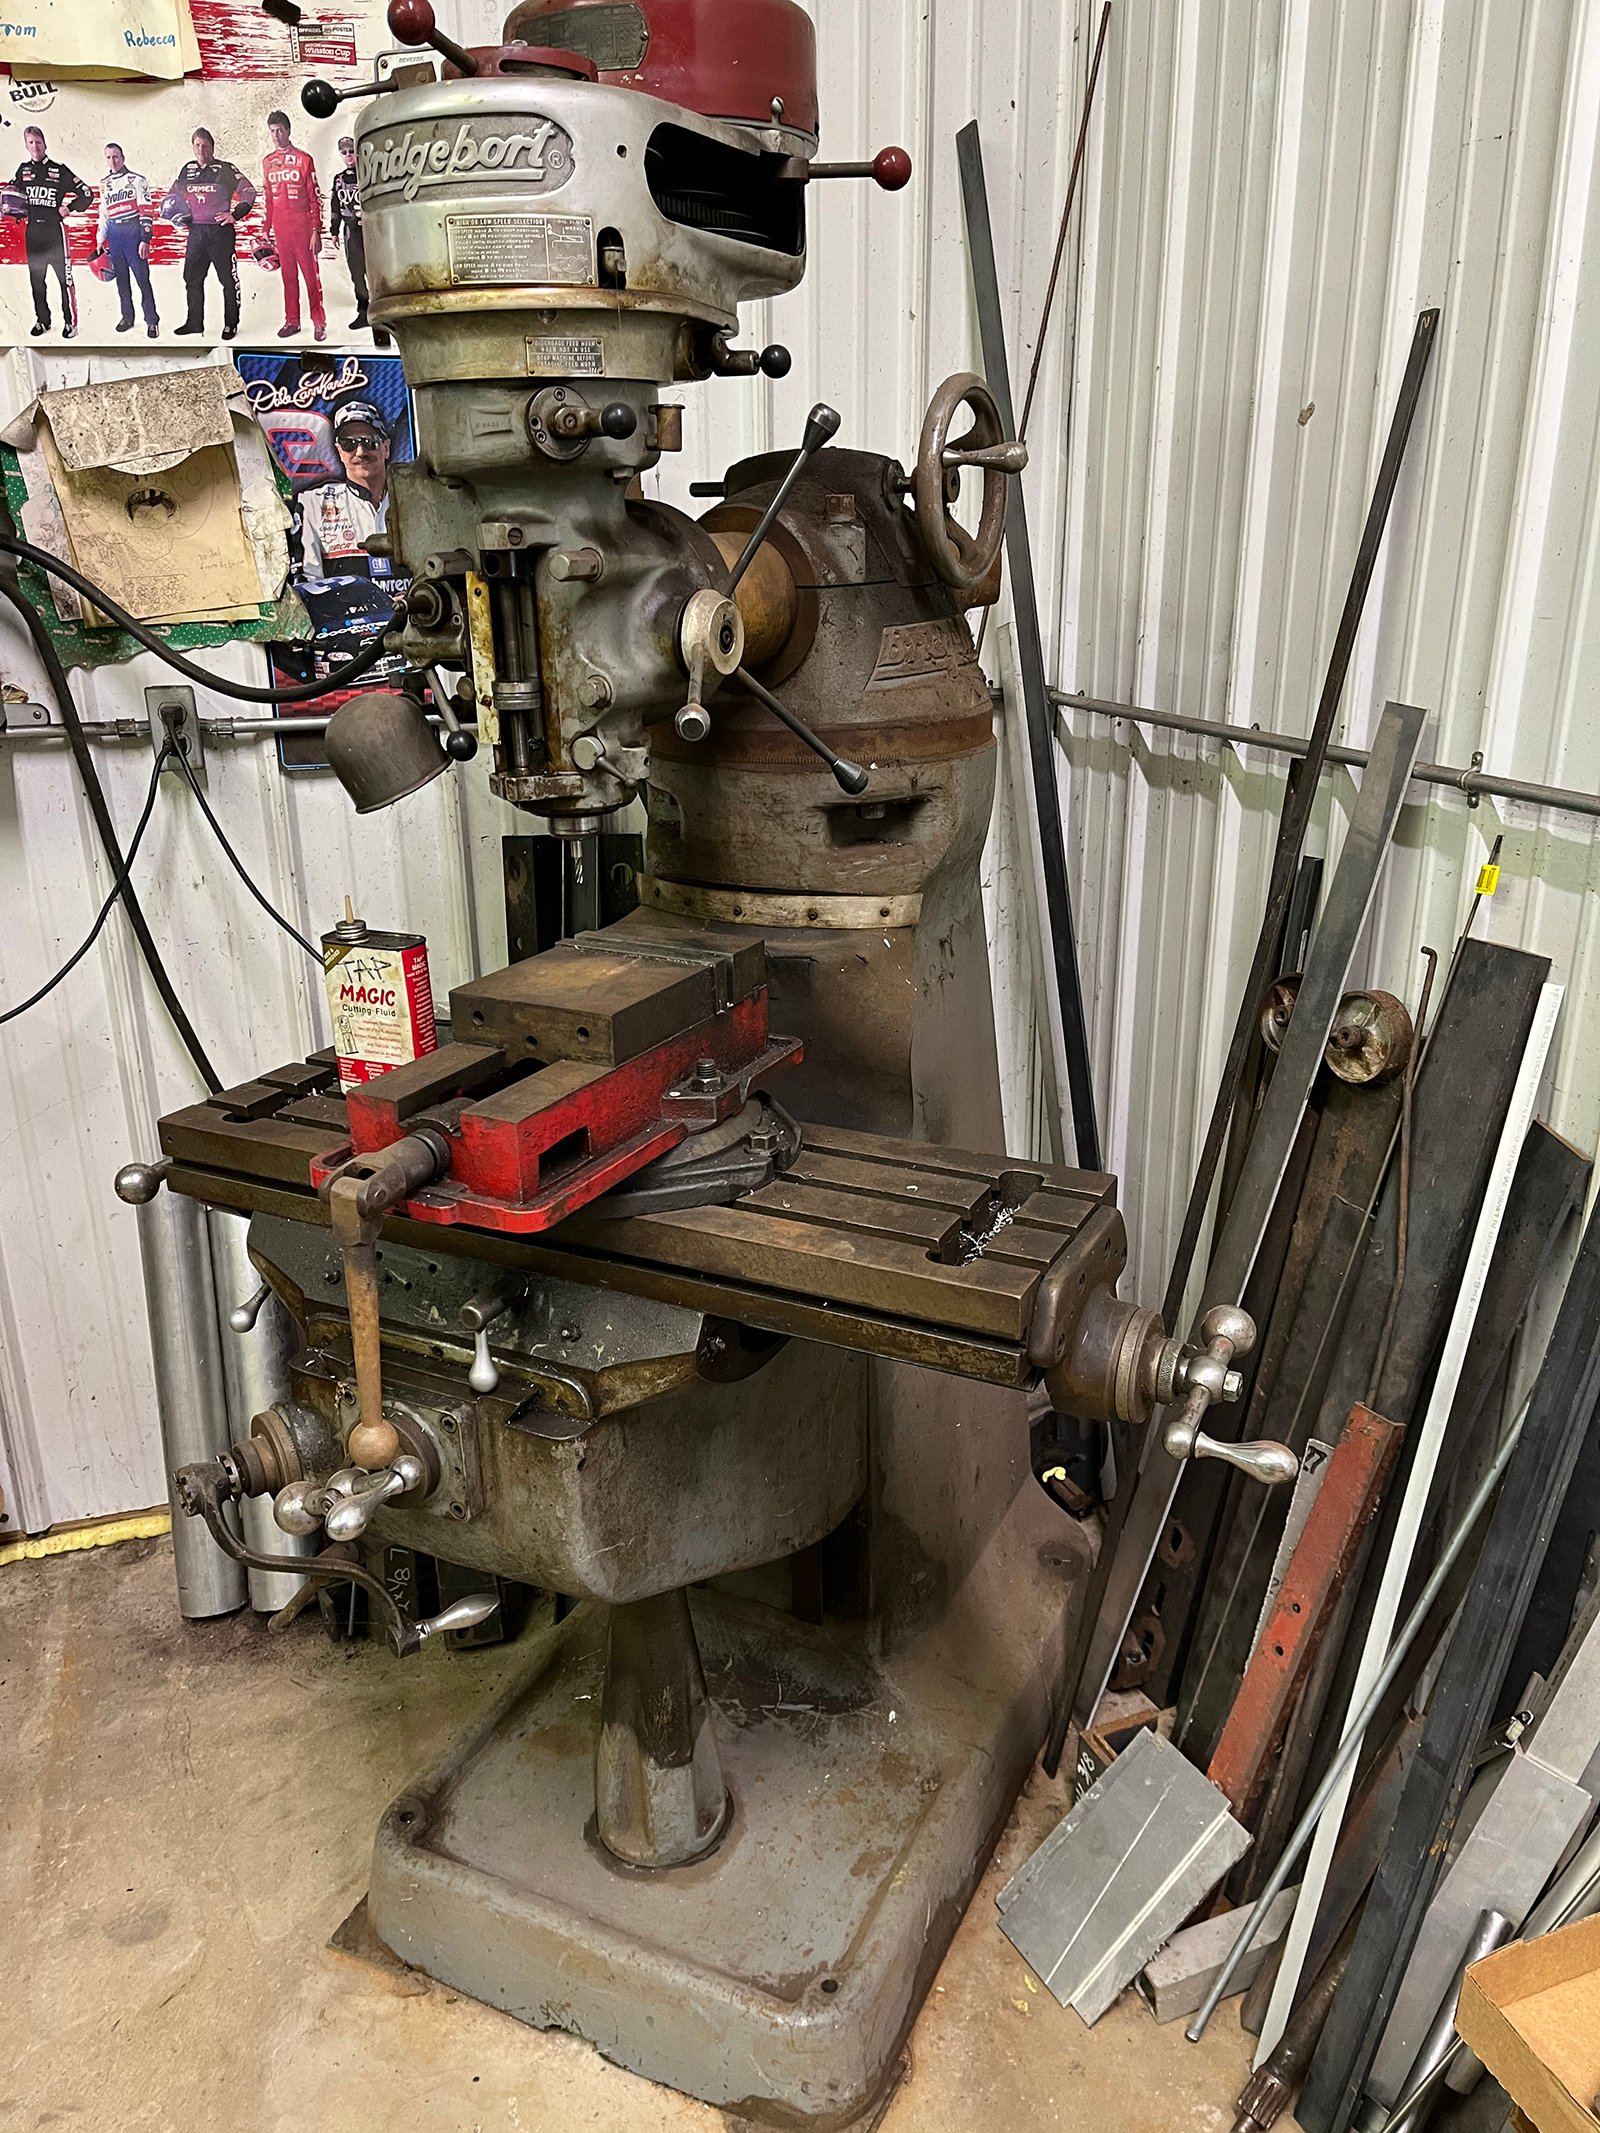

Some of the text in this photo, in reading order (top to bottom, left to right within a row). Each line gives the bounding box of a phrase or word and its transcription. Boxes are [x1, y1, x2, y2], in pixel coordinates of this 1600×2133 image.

[124, 27, 176, 47] Rebecca
[305, 46, 351, 58] Winston Cup
[9, 83, 58, 102] BULL
[358, 121, 555, 202] Bridgeport
[187, 185, 217, 193] CAMEL
[337, 957, 392, 984] TAP
[340, 984, 396, 1007] MAGIC
[342, 1003, 396, 1017] Cutting Fluid
